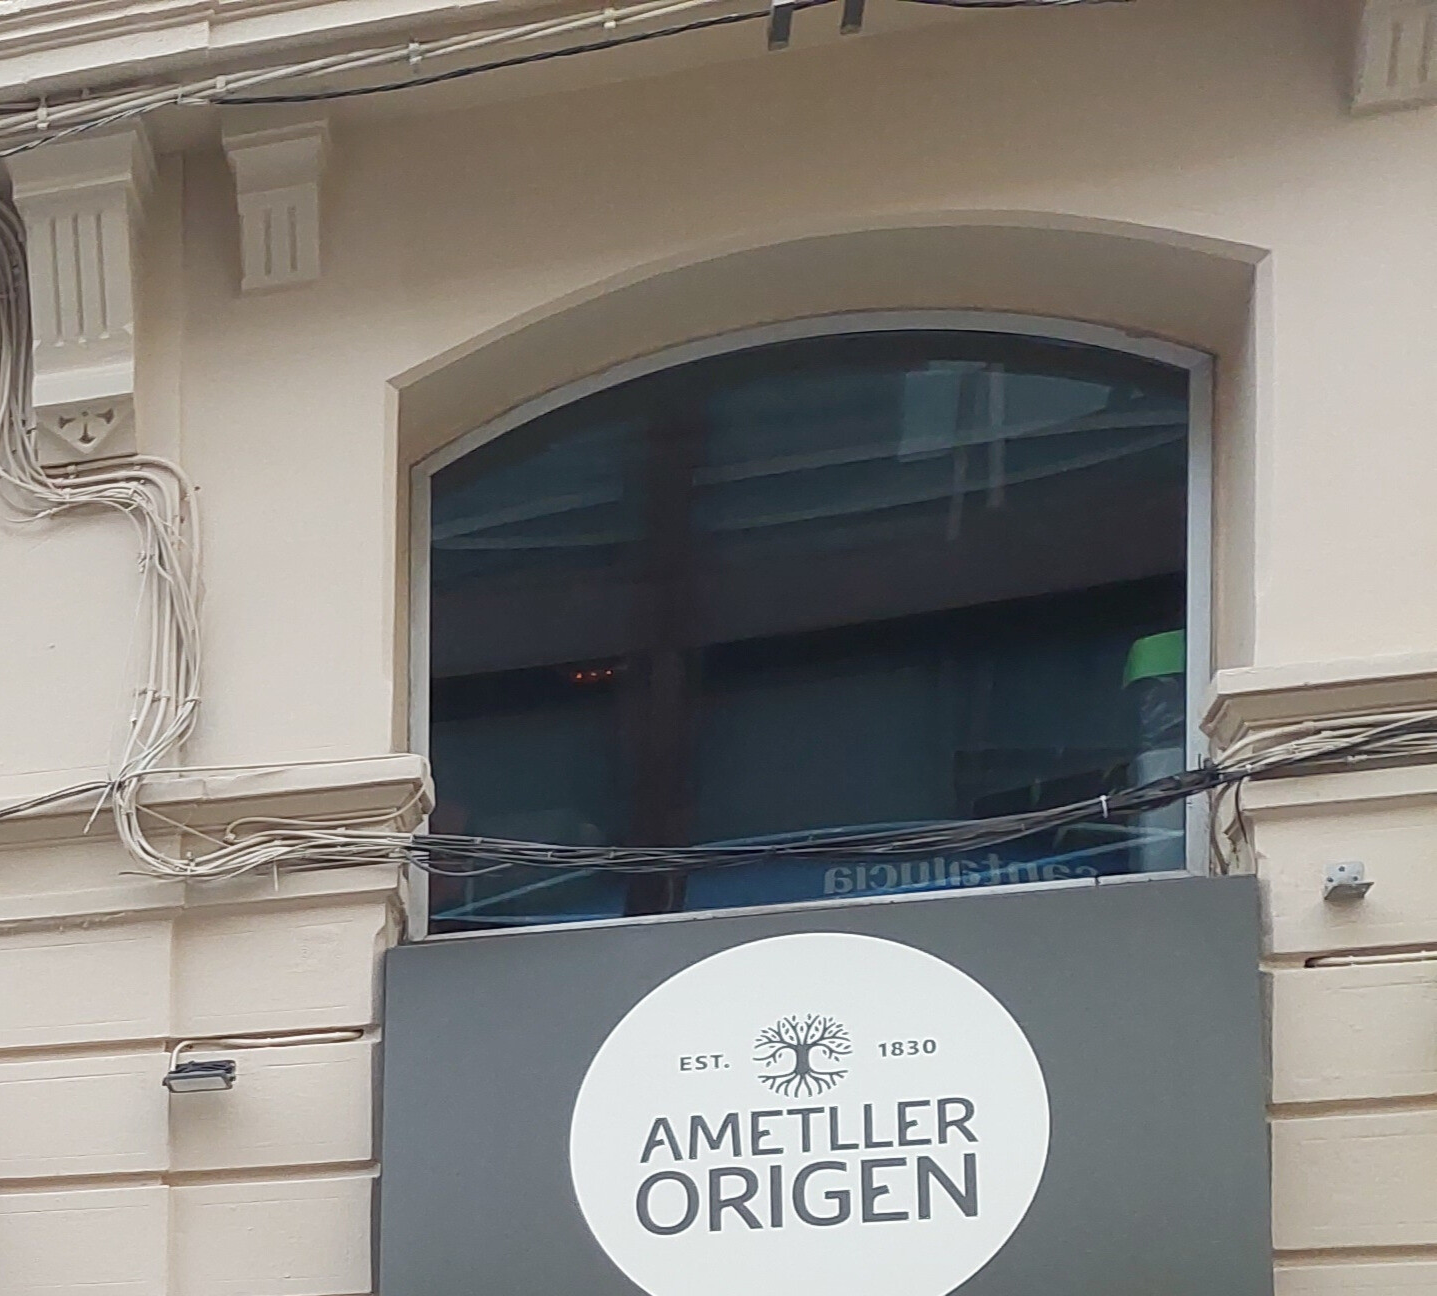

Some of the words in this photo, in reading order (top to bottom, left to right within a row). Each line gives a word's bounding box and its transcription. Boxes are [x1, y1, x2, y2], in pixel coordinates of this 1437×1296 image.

[680, 1054, 731, 1073] EST.
[878, 1039, 938, 1058] 1830
[640, 1096, 979, 1164] AMETLLER
[635, 1152, 979, 1237] ORIGEN
